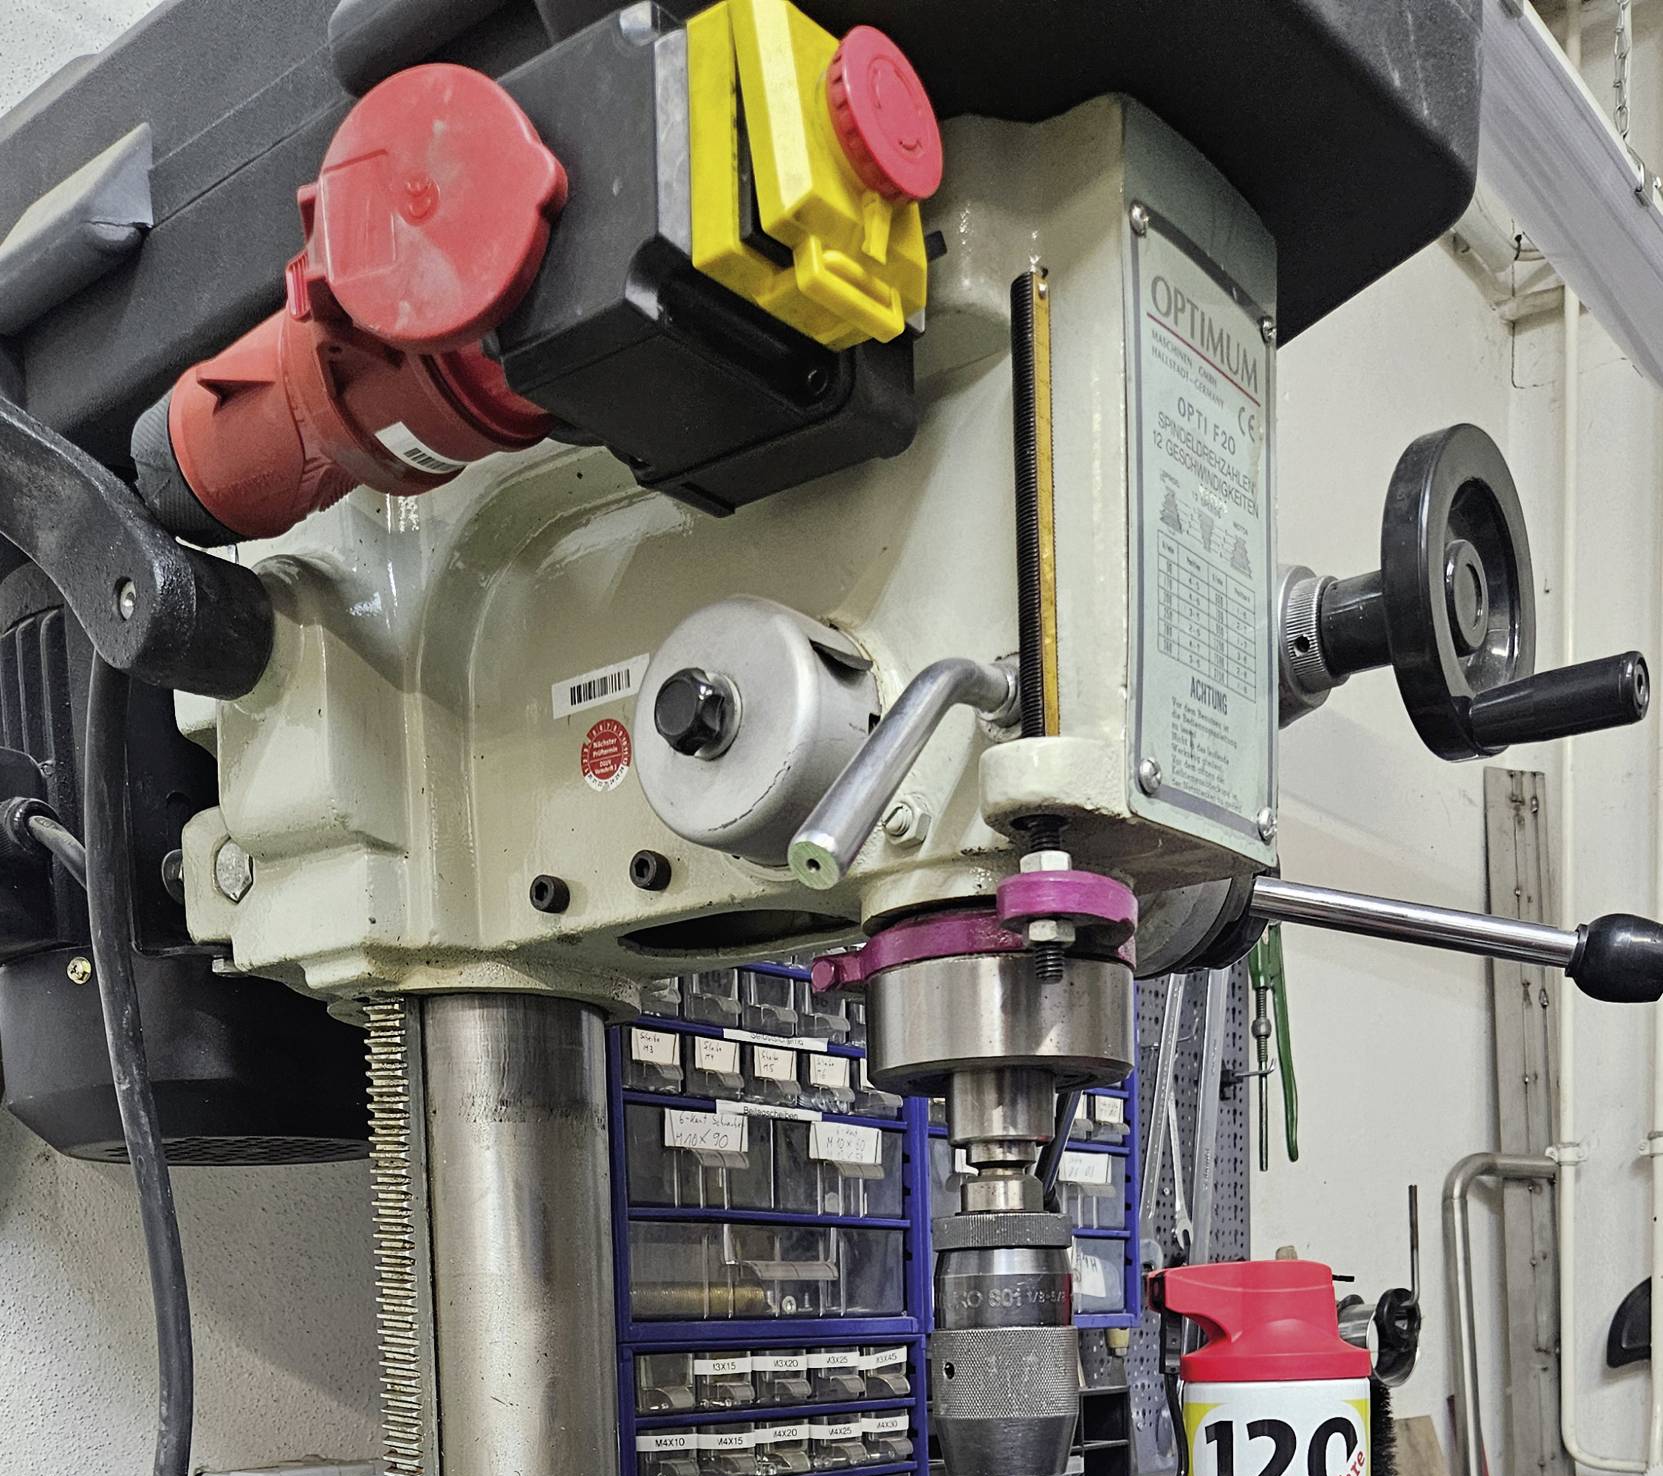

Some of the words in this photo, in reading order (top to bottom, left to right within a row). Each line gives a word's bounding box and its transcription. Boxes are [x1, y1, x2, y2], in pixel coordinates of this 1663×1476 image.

[1150, 275, 1259, 394] OPTIMUM
[1177, 396, 1208, 436] OPTI
[1212, 423, 1236, 456] F20
[1165, 438, 1260, 520] GESCHWINDIGKEITEN
[1190, 675, 1228, 716] ACHTUNG
[655, 1437, 686, 1448] M4X10
